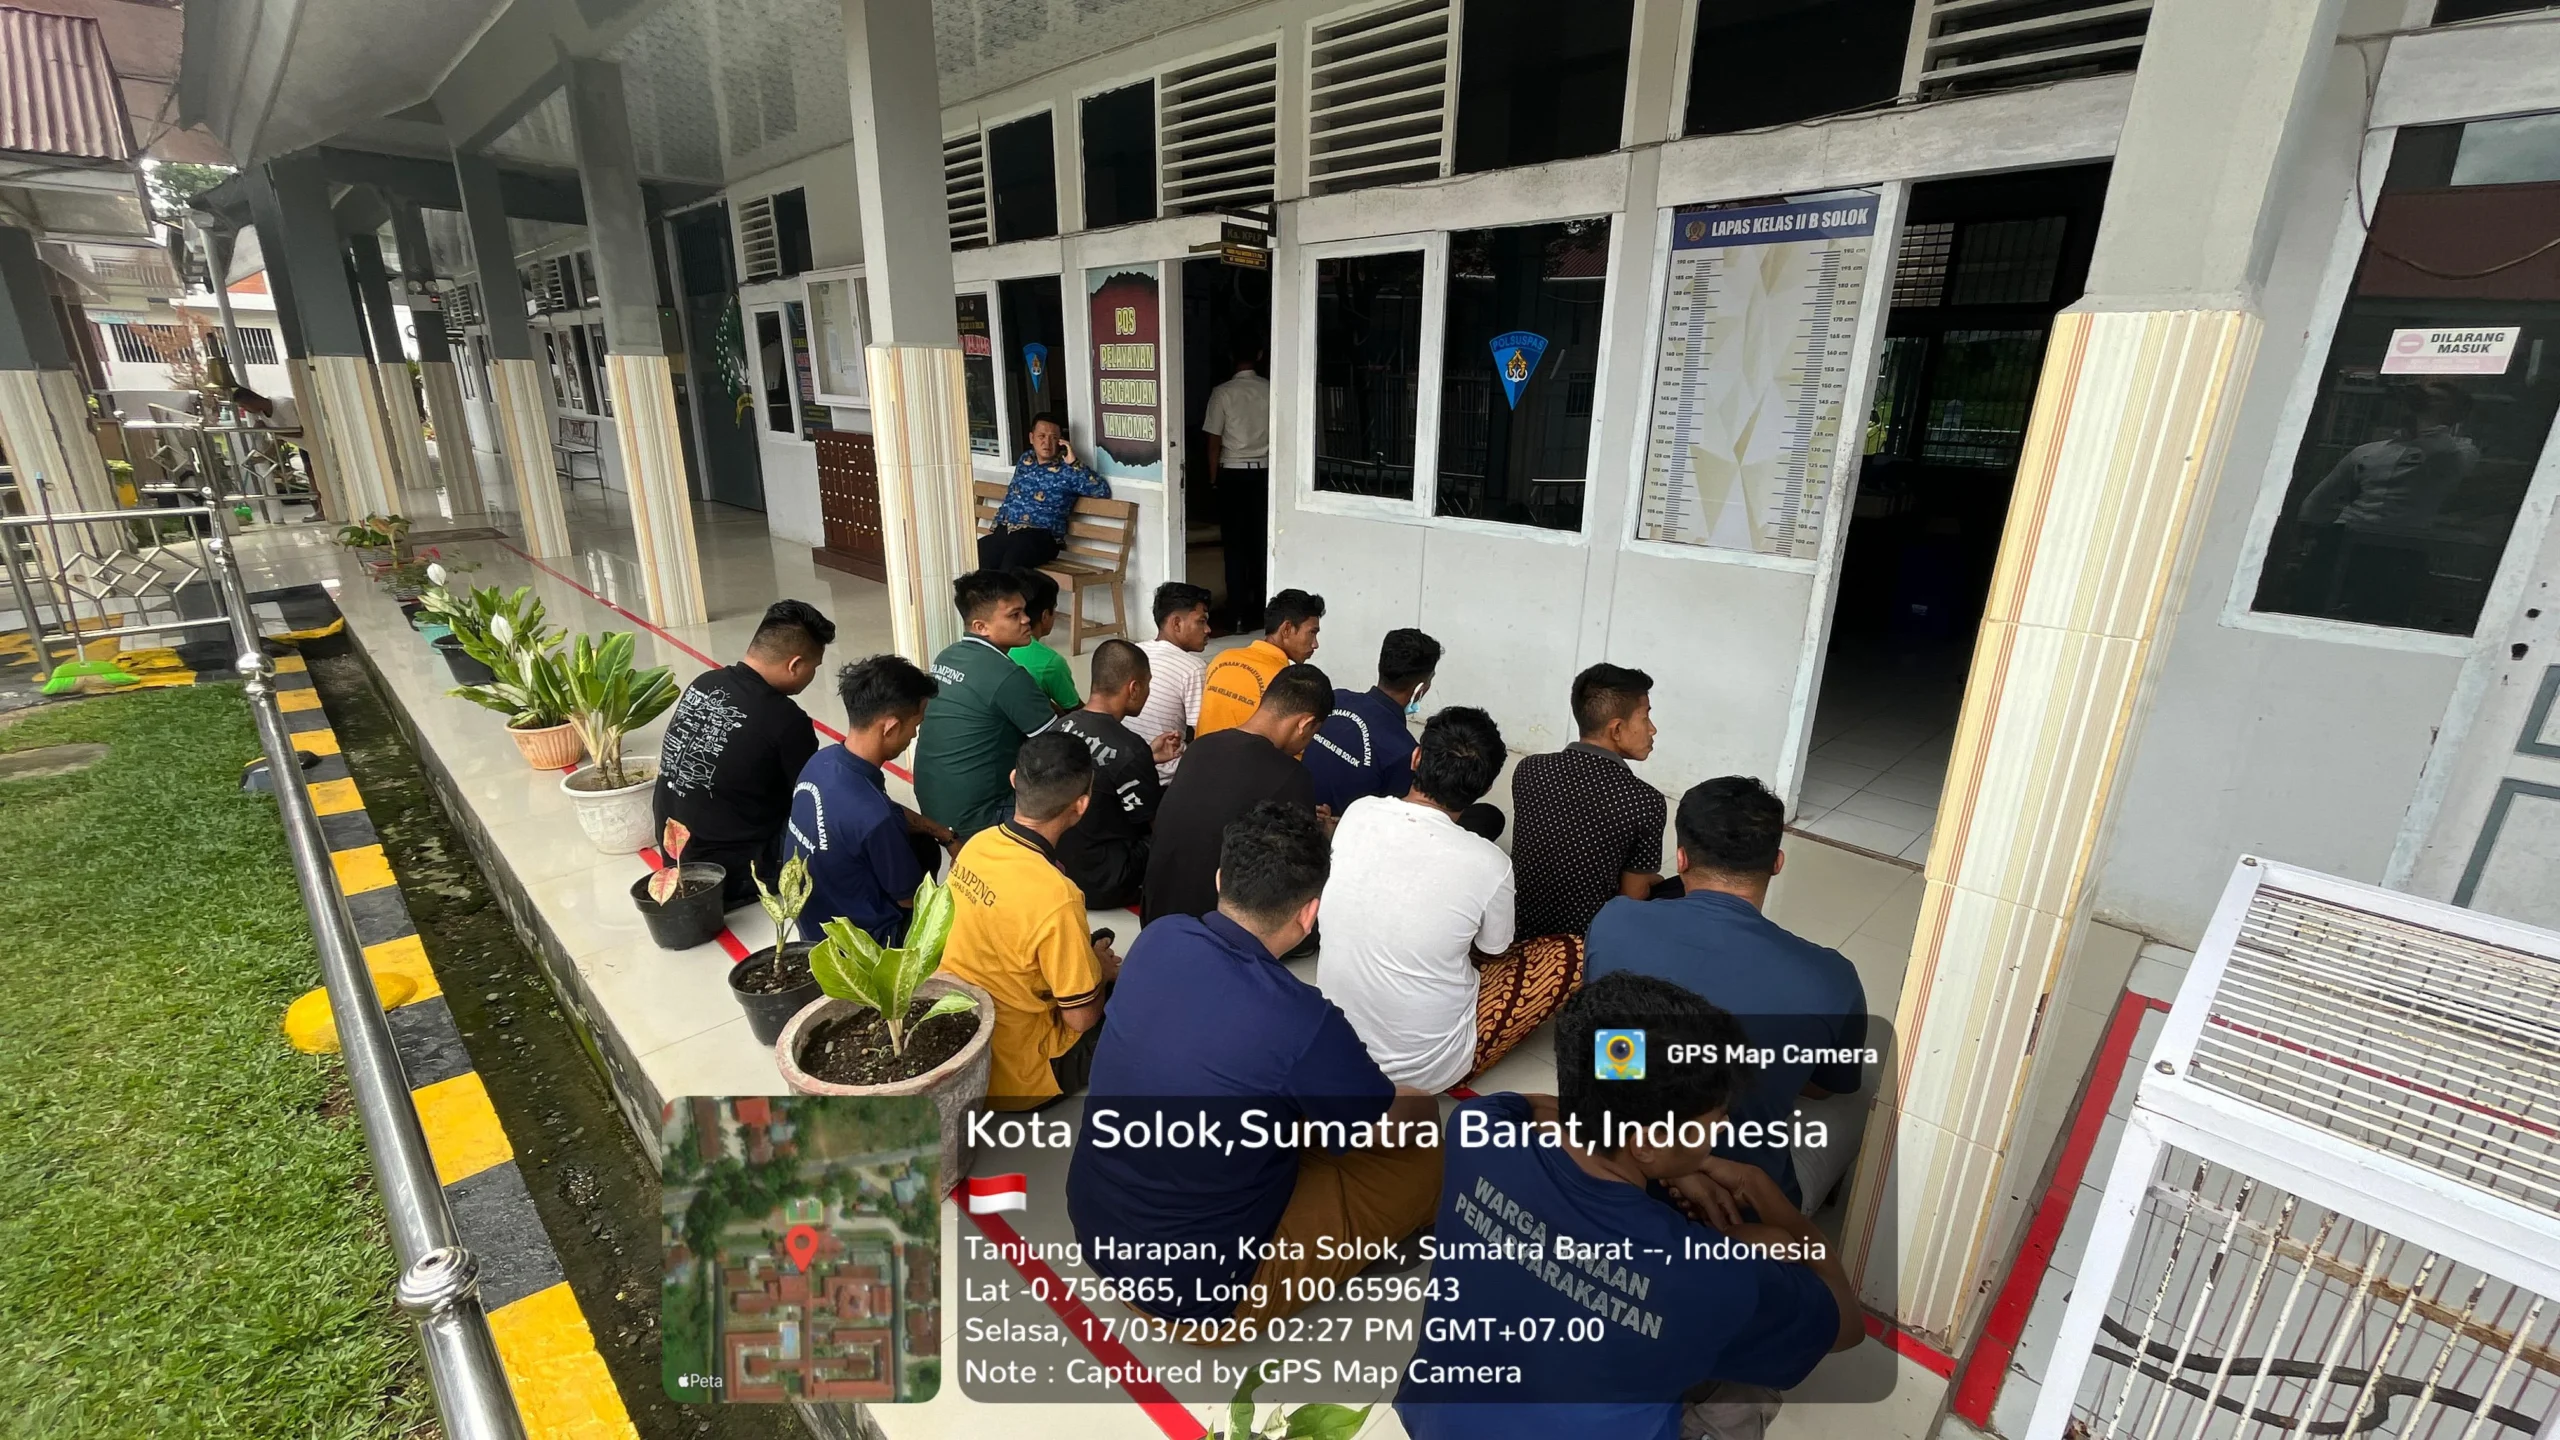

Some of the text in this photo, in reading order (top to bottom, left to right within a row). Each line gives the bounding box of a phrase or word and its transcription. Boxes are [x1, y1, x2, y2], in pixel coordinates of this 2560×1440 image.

[1711, 208, 1870, 237] LAPAS KELAS II B SOLOK
[1115, 307, 1137, 335] POS
[1492, 335, 1545, 351] POLSUSPAS
[2431, 332, 2505, 343] DILARANG
[2437, 343, 2492, 354] MASUK
[1100, 343, 1155, 371] PELAYANAN
[1100, 378, 1157, 407] PENGADUAN
[1102, 412, 1156, 442] YANKOMAS
[1328, 709, 1372, 767] INAAN PEMASYARAKATAN
[1341, 751, 1361, 768] SOLOK
[950, 862, 996, 908] AMPING
[1474, 1176, 1547, 1246] WARGA
[1454, 1192, 1663, 1341] PEMASYARAKATAN
